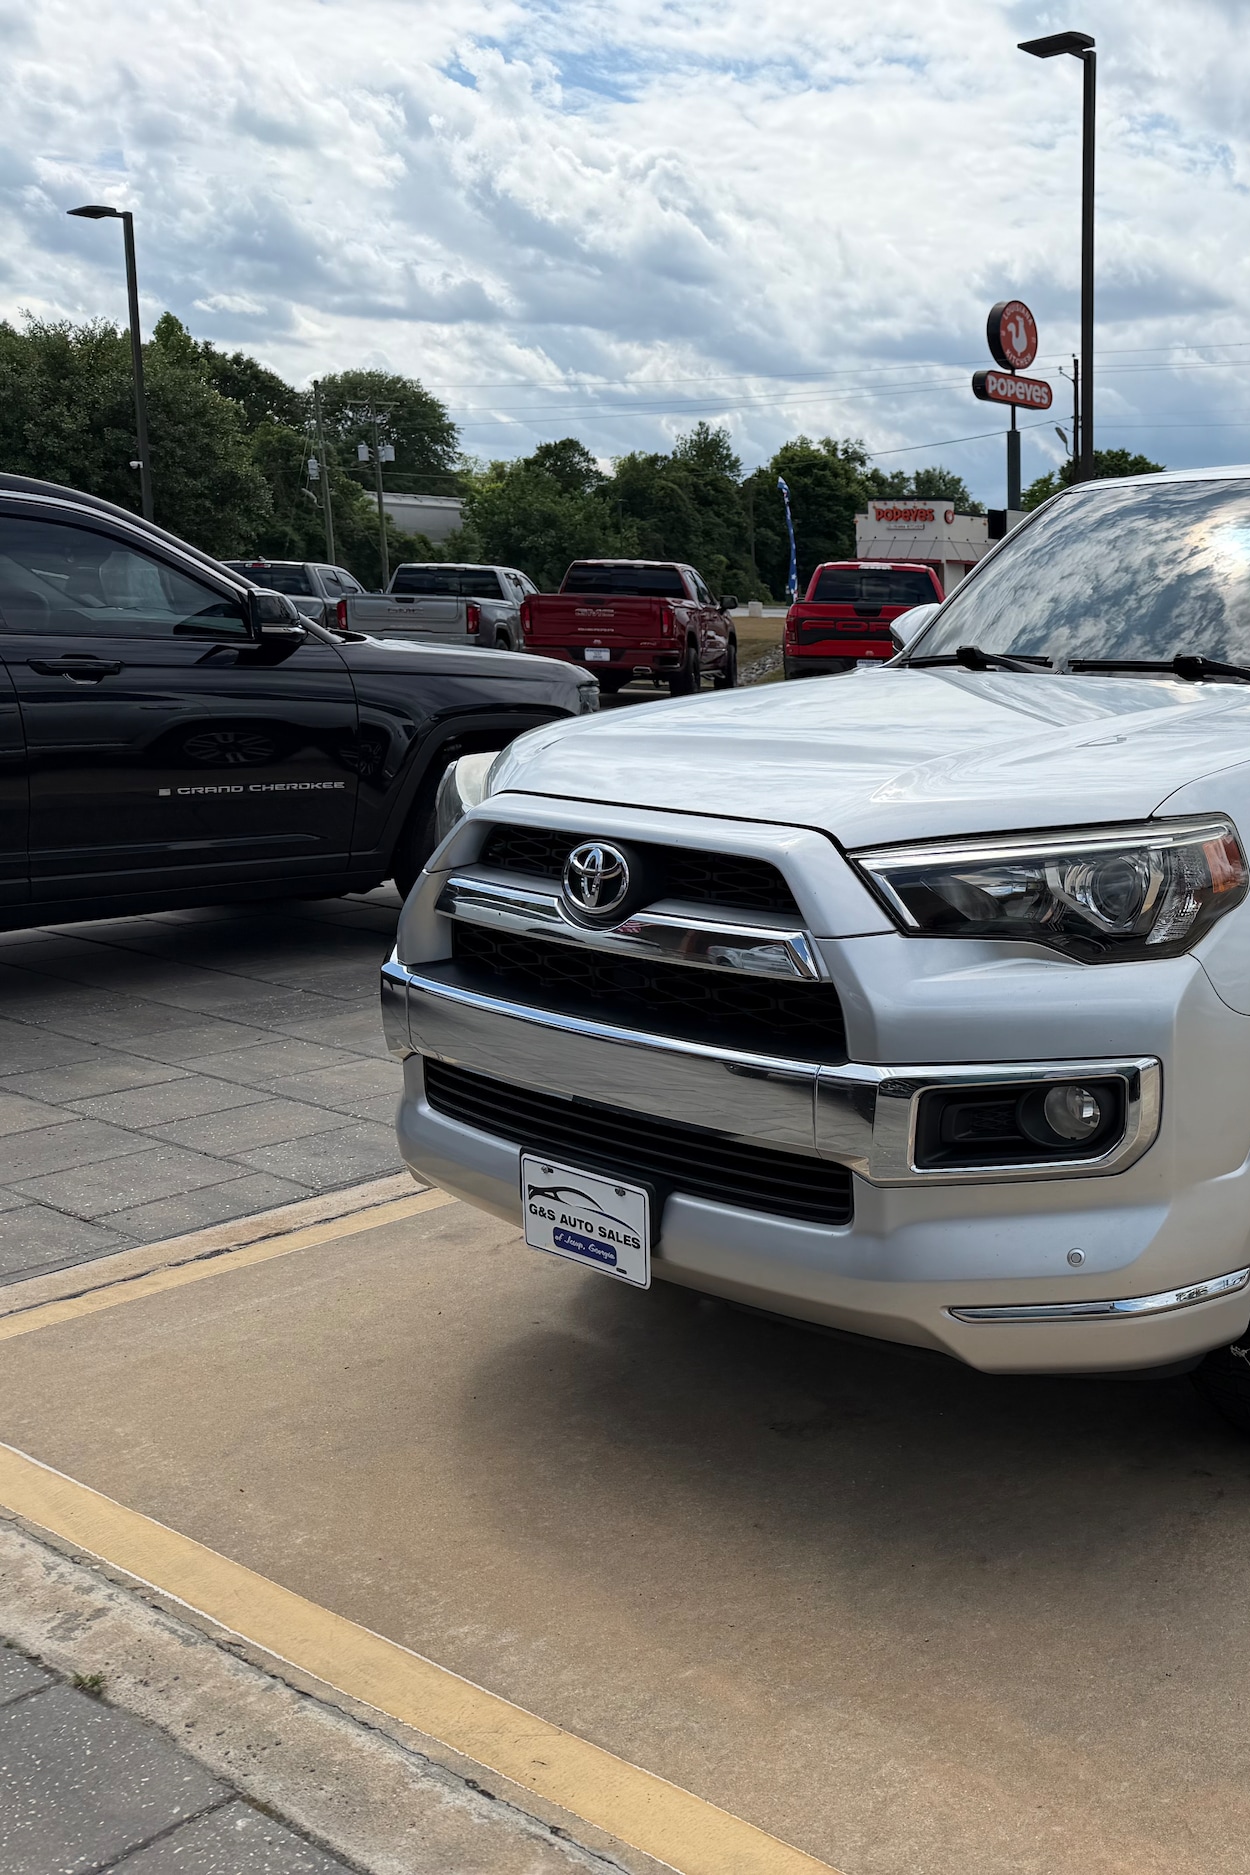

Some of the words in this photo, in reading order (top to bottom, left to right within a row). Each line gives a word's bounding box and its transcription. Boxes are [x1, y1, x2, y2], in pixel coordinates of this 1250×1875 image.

[1005, 349, 1032, 367] KITCHEN
[177, 785, 244, 795] GRAND
[249, 781, 345, 792] CHEROKEE
[529, 1203, 556, 1221] G&S
[560, 1214, 594, 1233] AUTO
[598, 1226, 641, 1249] SALES
